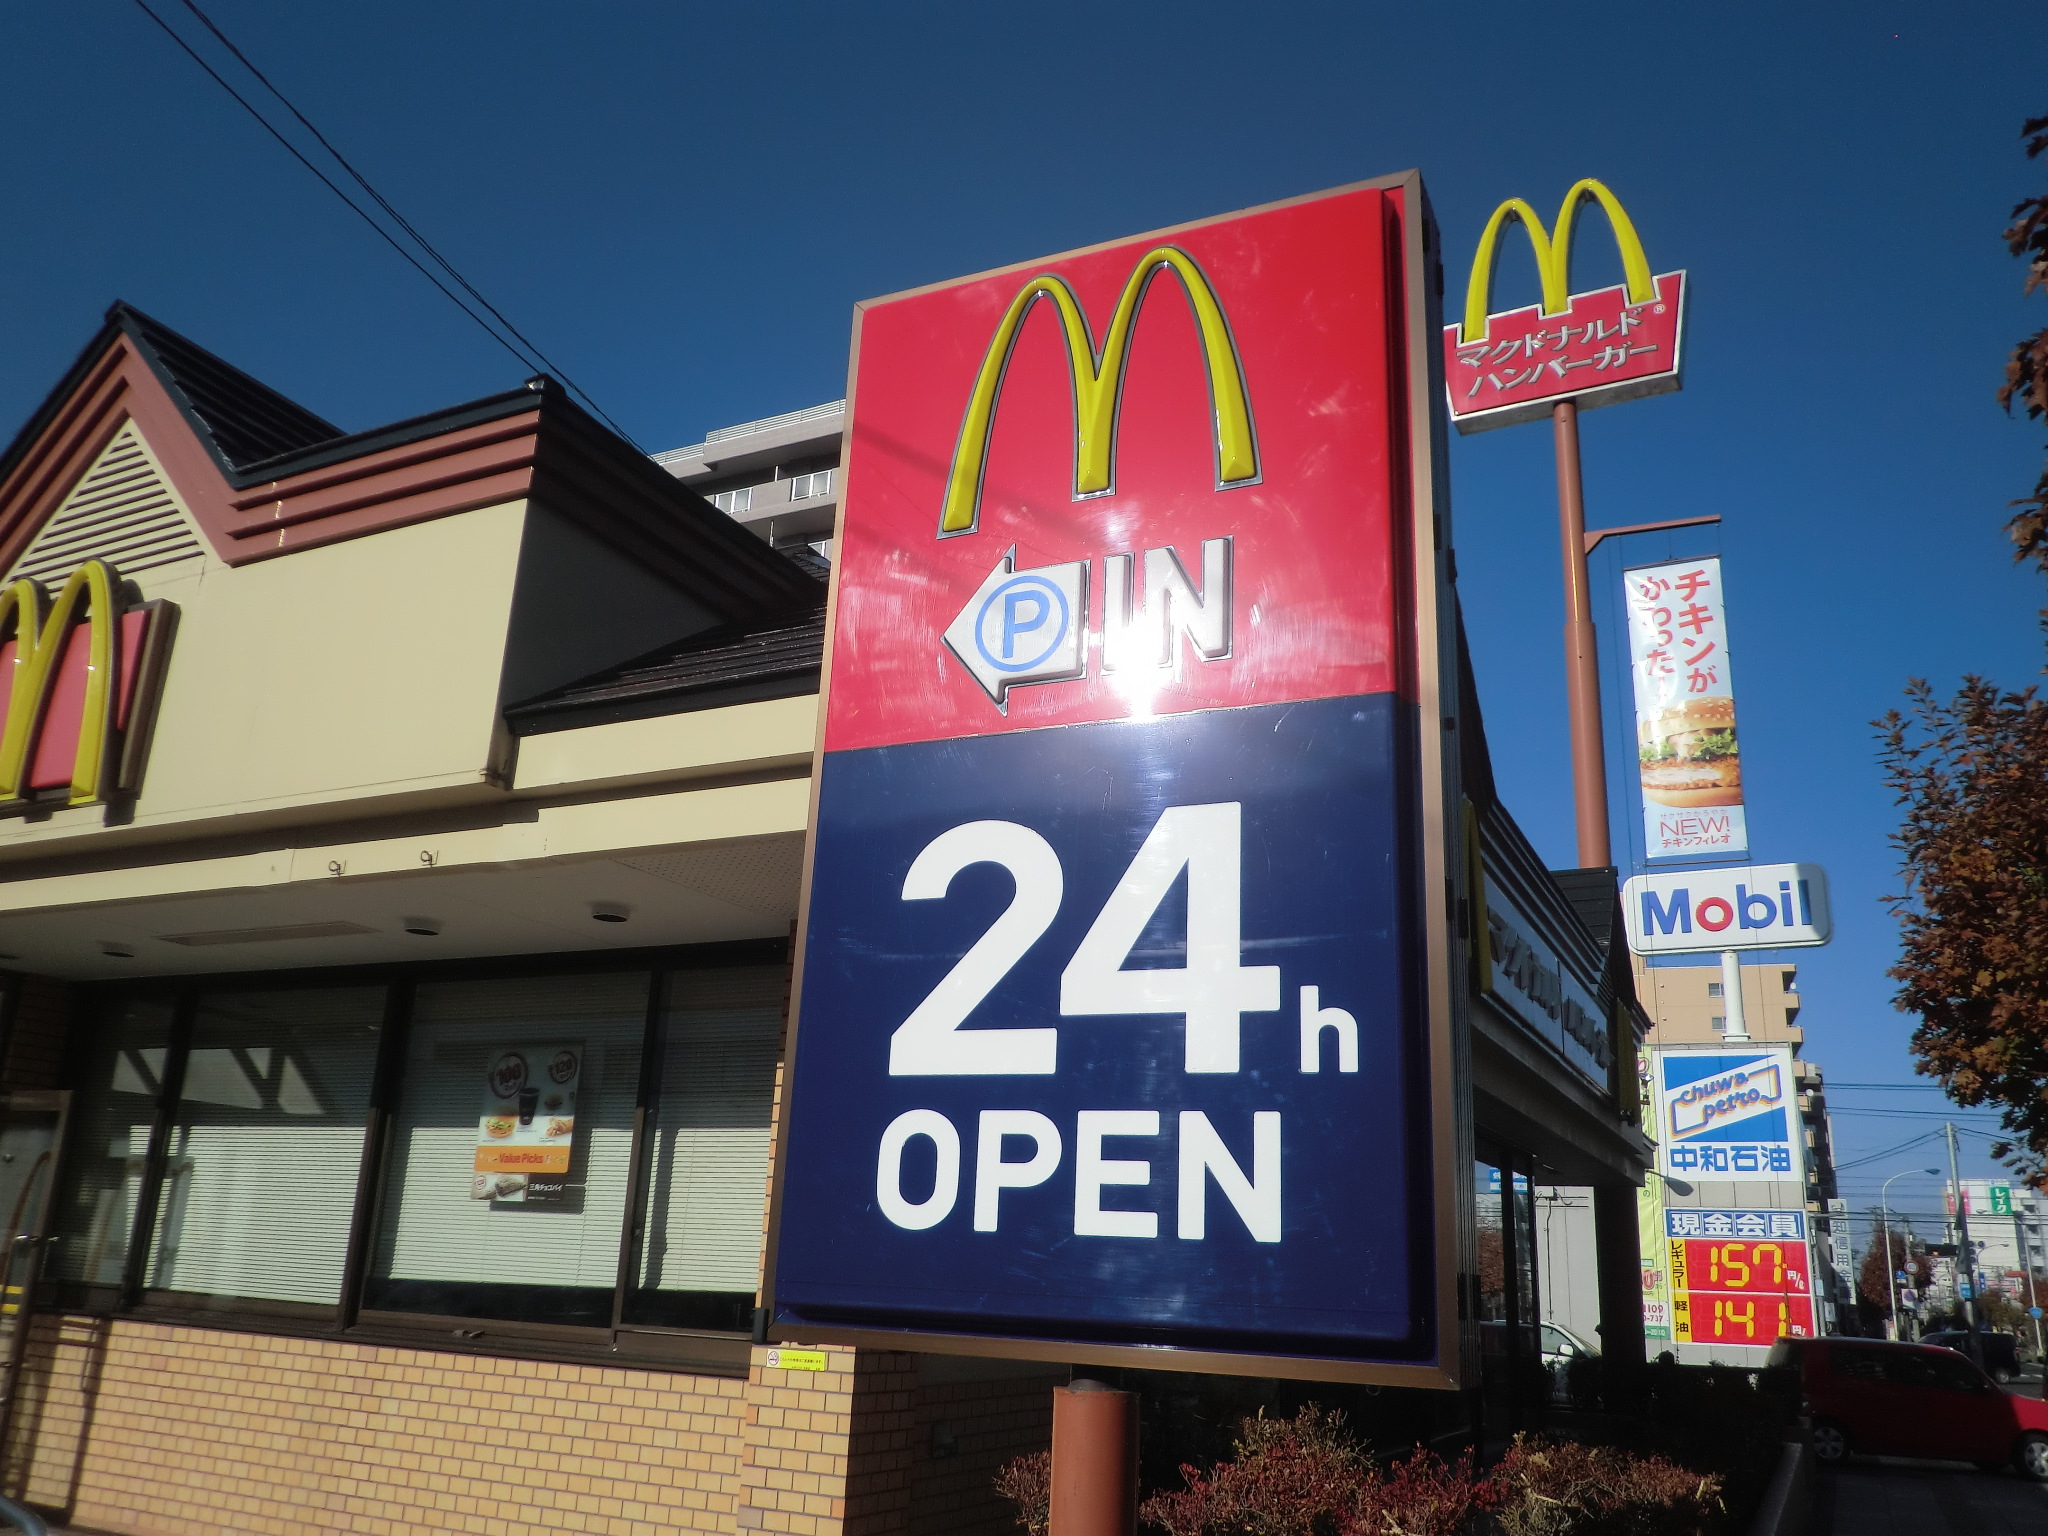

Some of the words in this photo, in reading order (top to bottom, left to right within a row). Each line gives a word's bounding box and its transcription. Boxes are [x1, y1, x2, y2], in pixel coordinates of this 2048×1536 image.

[1456, 307, 1645, 367] マクドナルド
[1467, 341, 1658, 398] ハンバーガー
[1002, 590, 1050, 660] P
[1102, 536, 1234, 674] IN
[1675, 569, 1718, 693] チキンが
[1660, 815, 1730, 837] NEW!
[1661, 833, 1731, 848] チキンフィレオ
[1641, 879, 1813, 937] Mobil
[500, 1153, 521, 1164] Value
[521, 1153, 543, 1164] Picks
[876, 1109, 1282, 1243] OPEN
[1670, 1145, 1792, 1172] 中和石油
[1995, 1187, 2007, 1212] レイク
[1671, 1213, 1800, 1237] 現金会員
[1671, 1240, 1685, 1288] レギュラー
[1674, 1300, 1690, 1333] 軽油
[1714, 1300, 1787, 1337] 141
